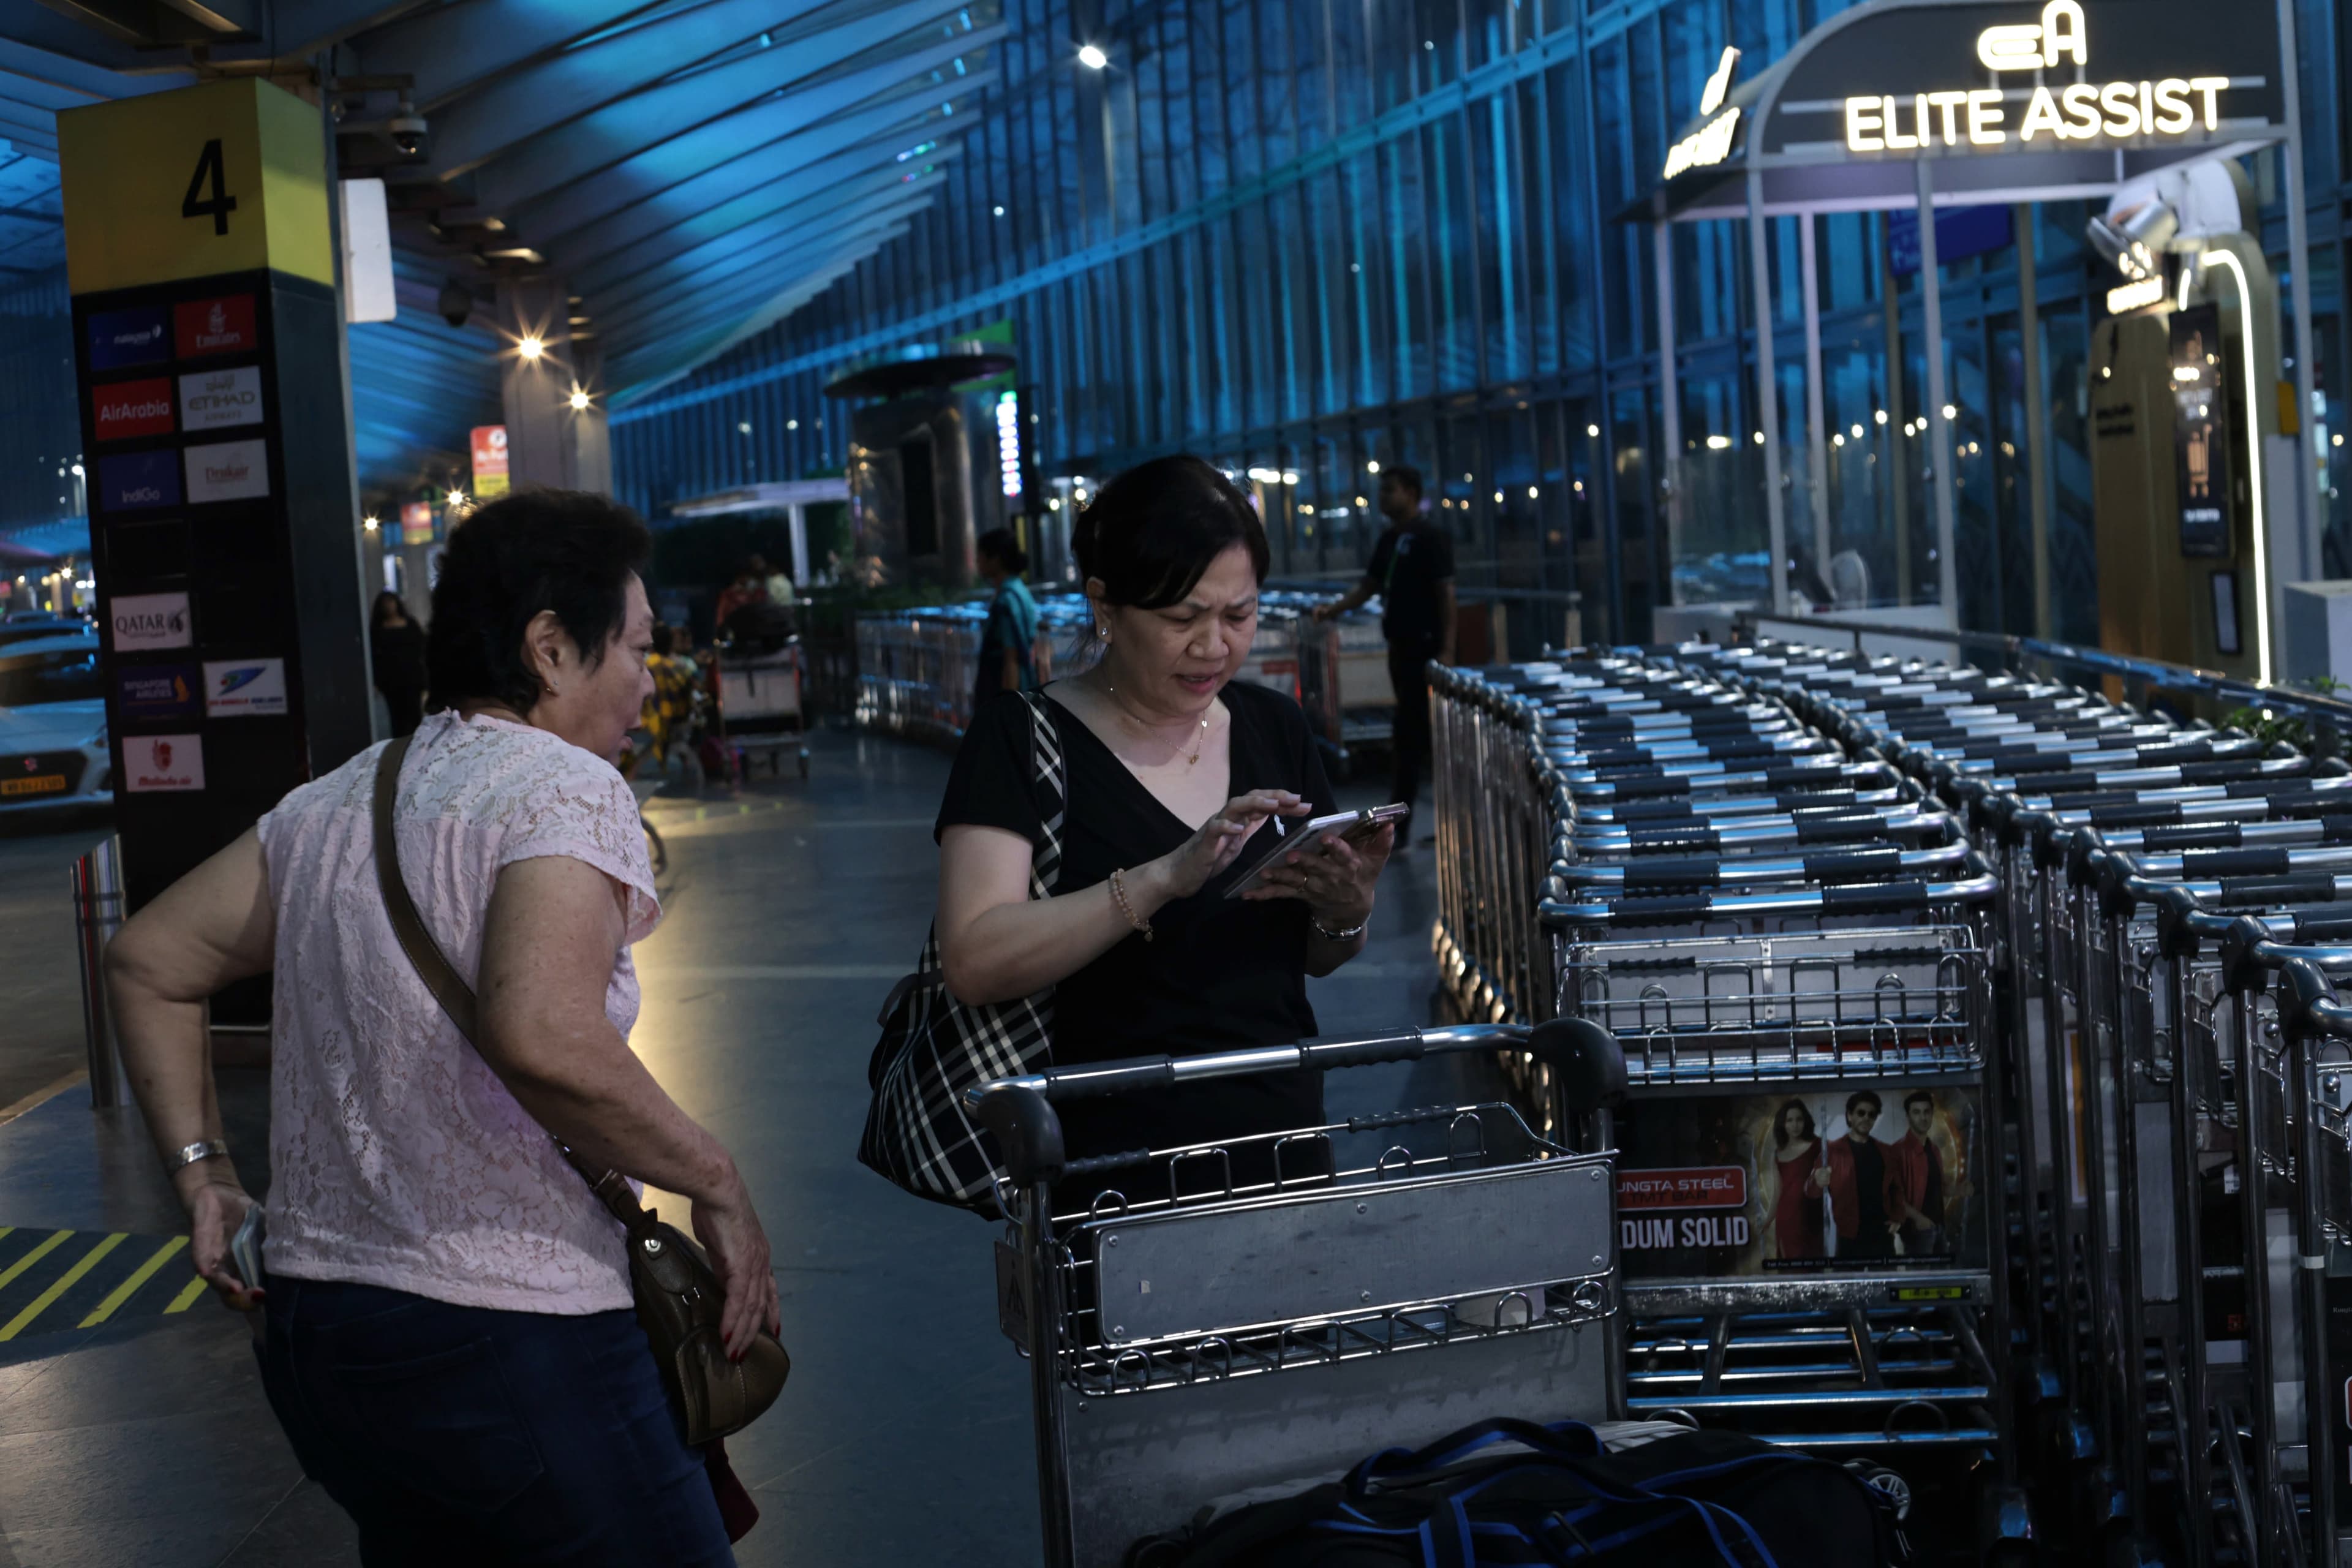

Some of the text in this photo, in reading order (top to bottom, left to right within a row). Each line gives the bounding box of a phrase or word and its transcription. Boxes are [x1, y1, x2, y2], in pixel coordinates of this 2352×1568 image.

[1845, 77, 2230, 151] ELITE ASSIST
[181, 138, 237, 236] 4
[100, 400, 170, 422] AirArabia
[189, 391, 255, 411] ETIHAD
[123, 487, 160, 503] IndiGo
[115, 614, 166, 635] QATAR
[1678, 1178, 1735, 1191] STEEL
[1630, 1189, 1708, 1204] TMT BAR
[1619, 1216, 1749, 1250] DUM SOLID
